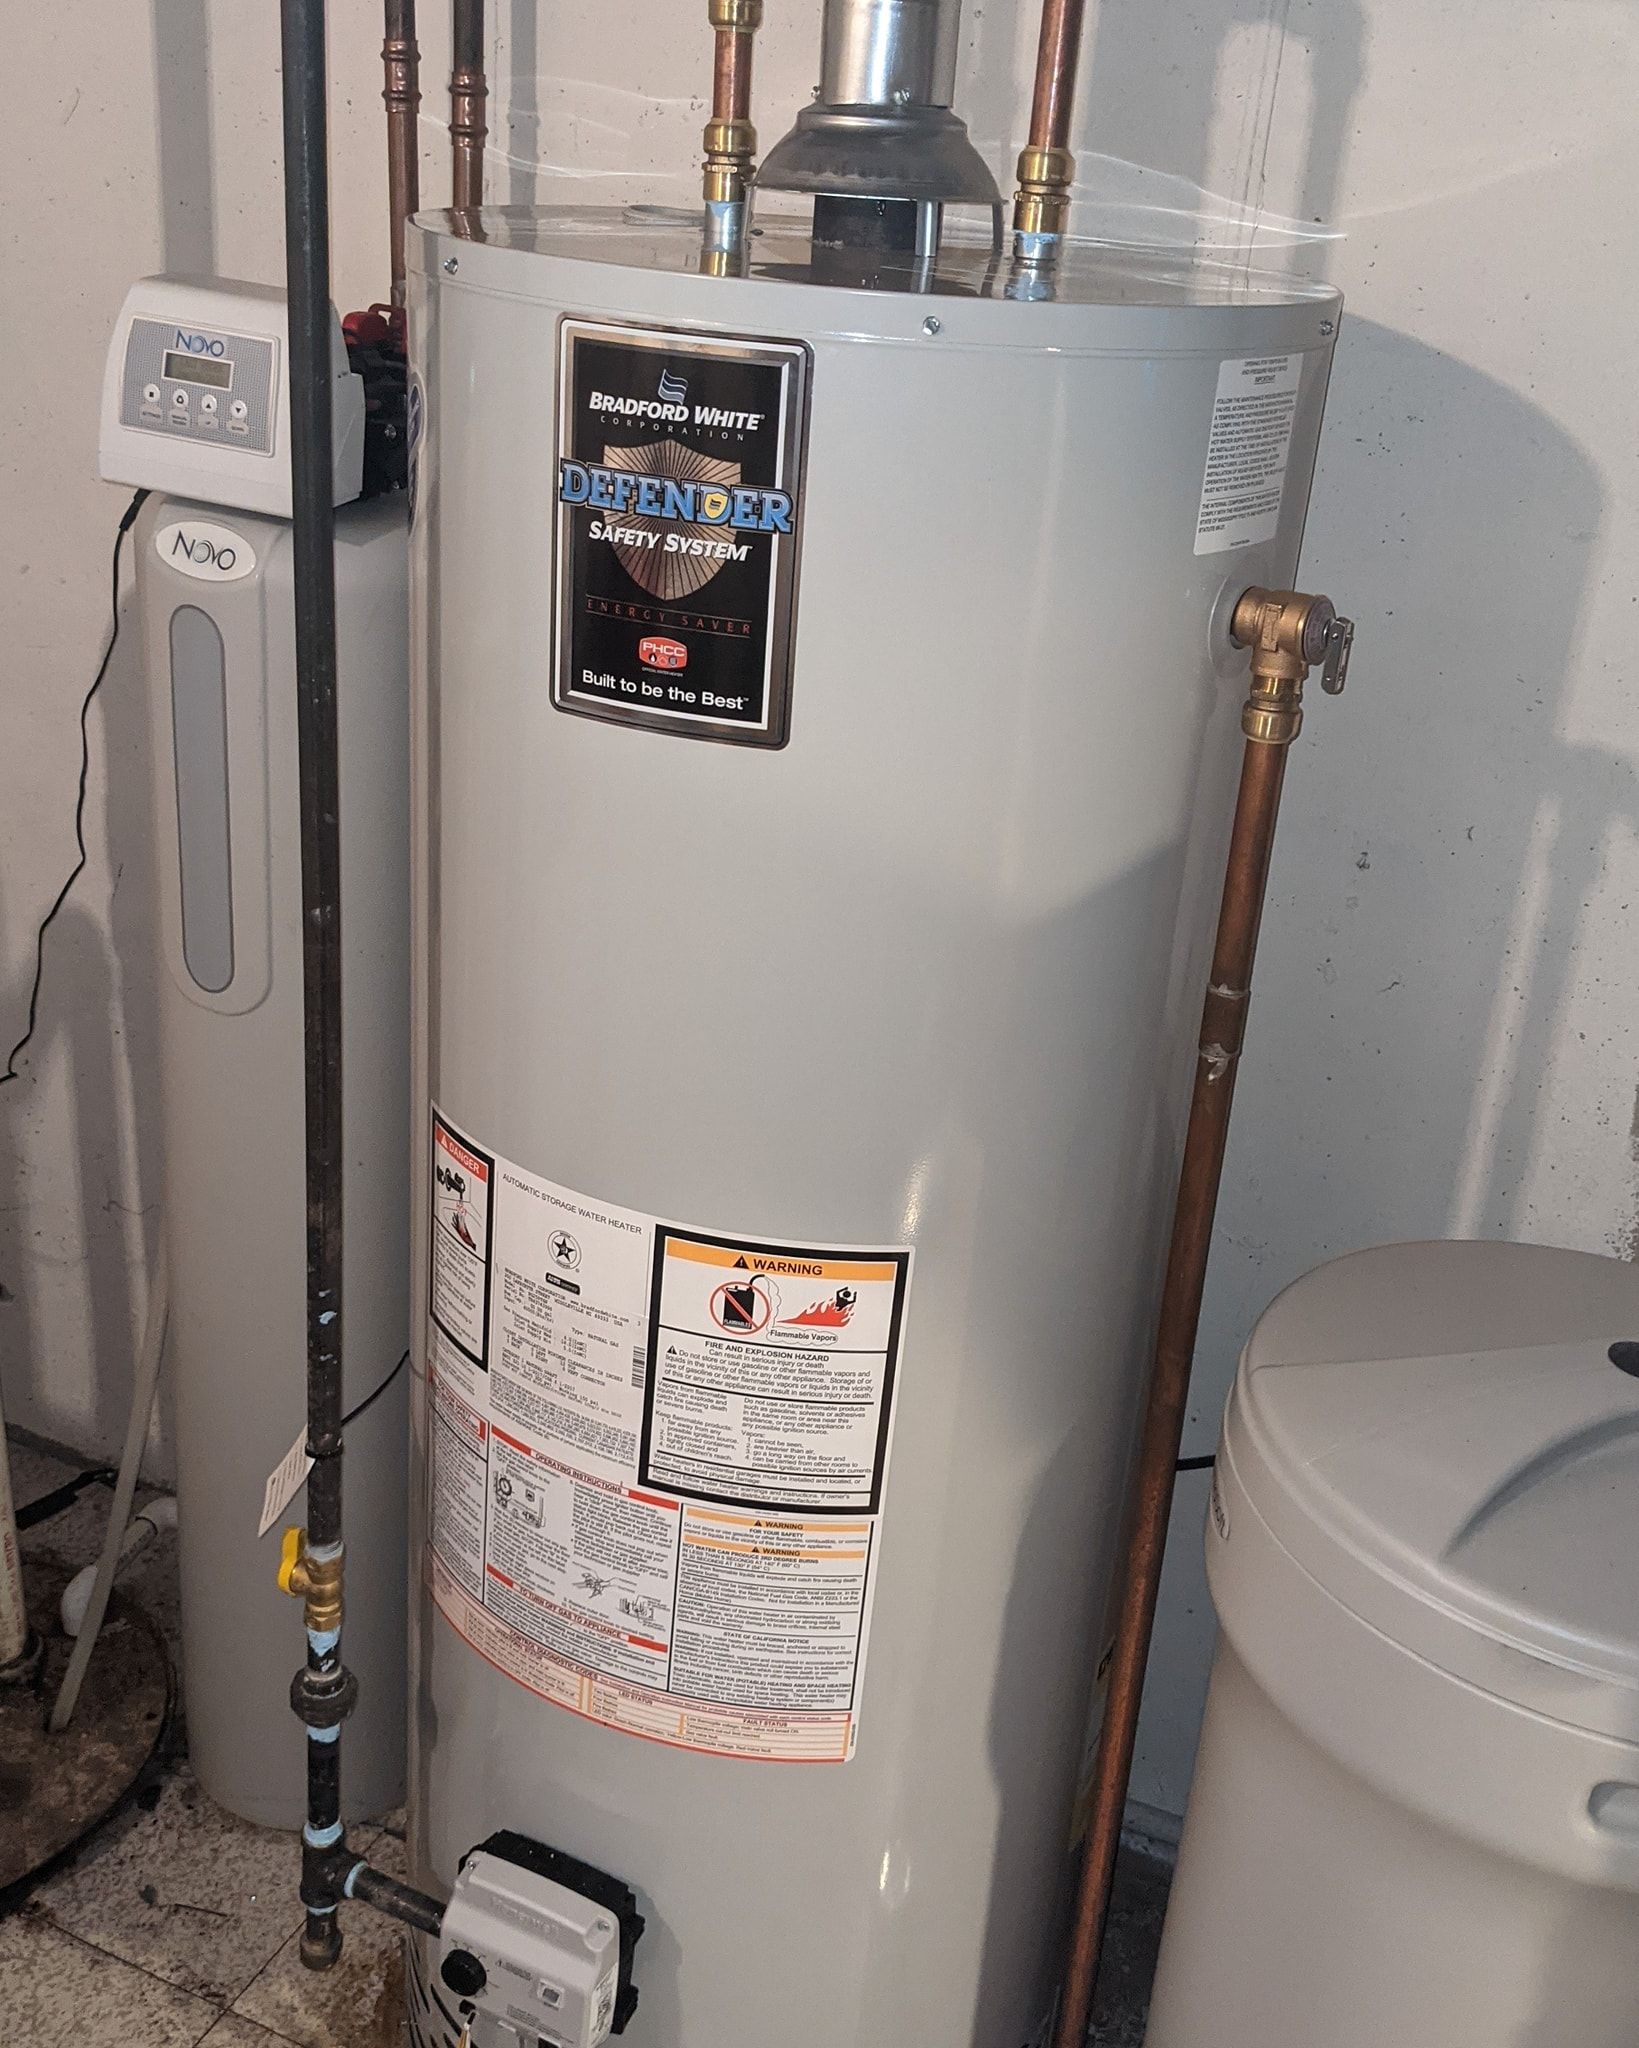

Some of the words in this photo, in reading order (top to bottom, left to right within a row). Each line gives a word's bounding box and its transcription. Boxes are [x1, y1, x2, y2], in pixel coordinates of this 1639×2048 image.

[589, 391, 689, 422] BRADFORD
[600, 415, 744, 441] CORPORATION
[560, 458, 794, 534] DEFENDER
[589, 520, 662, 549] SAFETY
[587, 599, 665, 622] ENERGY
[682, 616, 750, 634] SAVER
[643, 642, 685, 657] PHCC
[582, 669, 616, 689] Built
[620, 678, 637, 693] to
[642, 682, 663, 698] be
[668, 687, 696, 703] the
[450, 1145, 479, 1174] DANGER
[503, 1173, 540, 1198] AUTOMATIC
[541, 1193, 577, 1214] STORAGE
[578, 1208, 607, 1224] WATER
[608, 1218, 642, 1235] HEATER
[754, 1258, 823, 1276] WARNING
[770, 1330, 809, 1341] Flammable
[811, 1332, 838, 1342] Vapors
[705, 1341, 723, 1349] FIRE
[746, 1348, 792, 1359] EXPLOSION
[795, 1354, 829, 1362] HAZARD
[724, 1352, 742, 1360] result
[752, 1356, 776, 1364] serious
[665, 1354, 685, 1364] liquids
[707, 1362, 728, 1373] vicinity
[738, 1367, 749, 1375] this
[702, 1355, 718, 1363] store
[742, 1361, 769, 1370] gasoline
[798, 1368, 832, 1376] flammable
[686, 1367, 713, 1377] gasoline
[723, 1373, 739, 1381] other
[741, 1376, 774, 1386] flammable
[809, 1383, 830, 1391] liquids
[693, 1375, 705, 1383] any
[706, 1378, 723, 1386] other
[725, 1380, 756, 1391] appliance
[534, 1452, 571, 1474] OPERATING
[571, 1469, 621, 1493] INSTRUCTIONS
[766, 1522, 803, 1530] WARNING
[763, 1547, 800, 1556] WARNING
